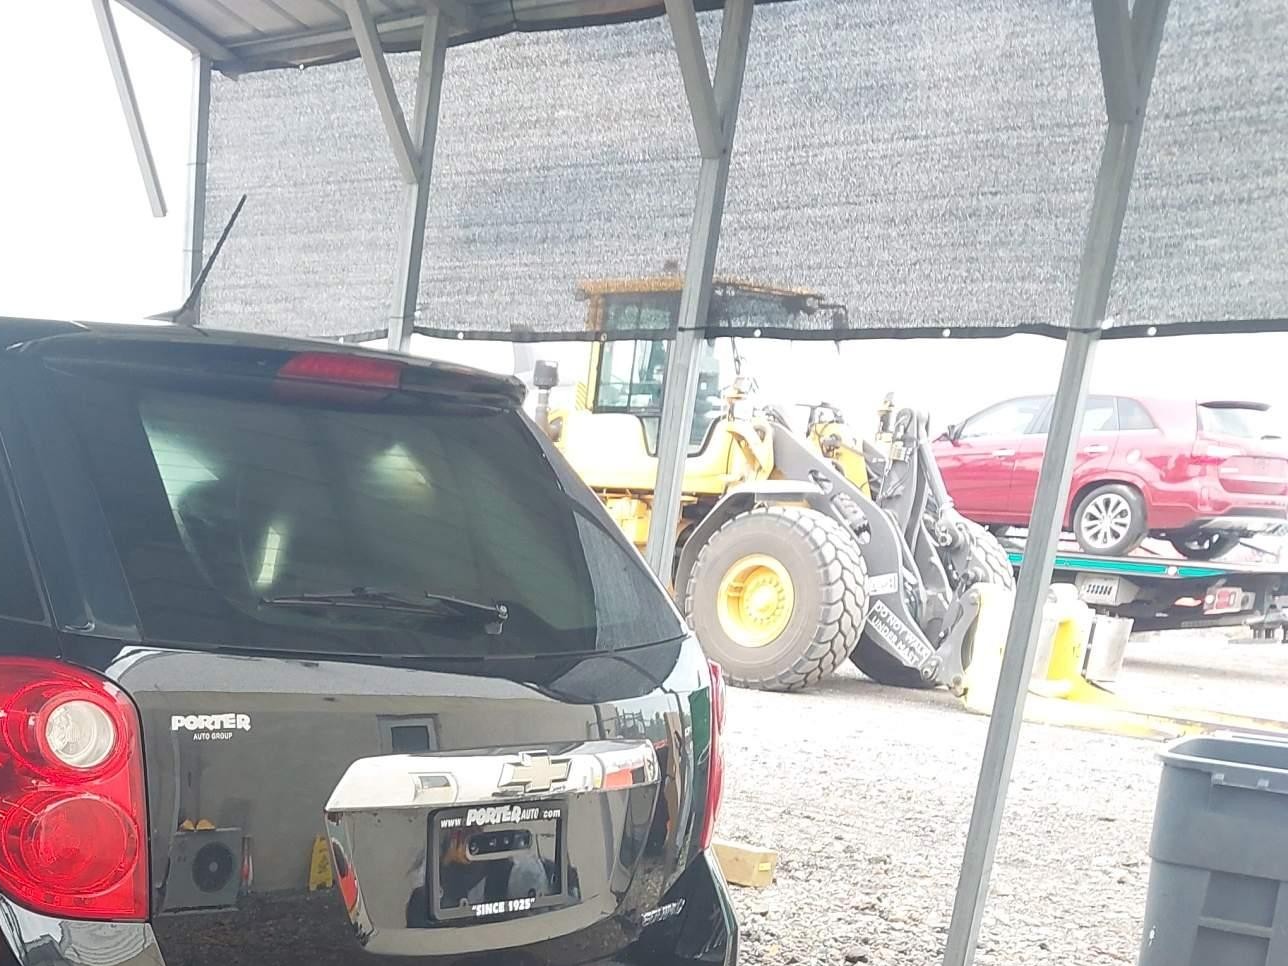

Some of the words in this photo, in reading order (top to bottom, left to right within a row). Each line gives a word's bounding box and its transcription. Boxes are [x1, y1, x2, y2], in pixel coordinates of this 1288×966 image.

[171, 713, 251, 731] PORTER
[193, 732, 211, 740] AUTO
[211, 732, 233, 740] GROUP
